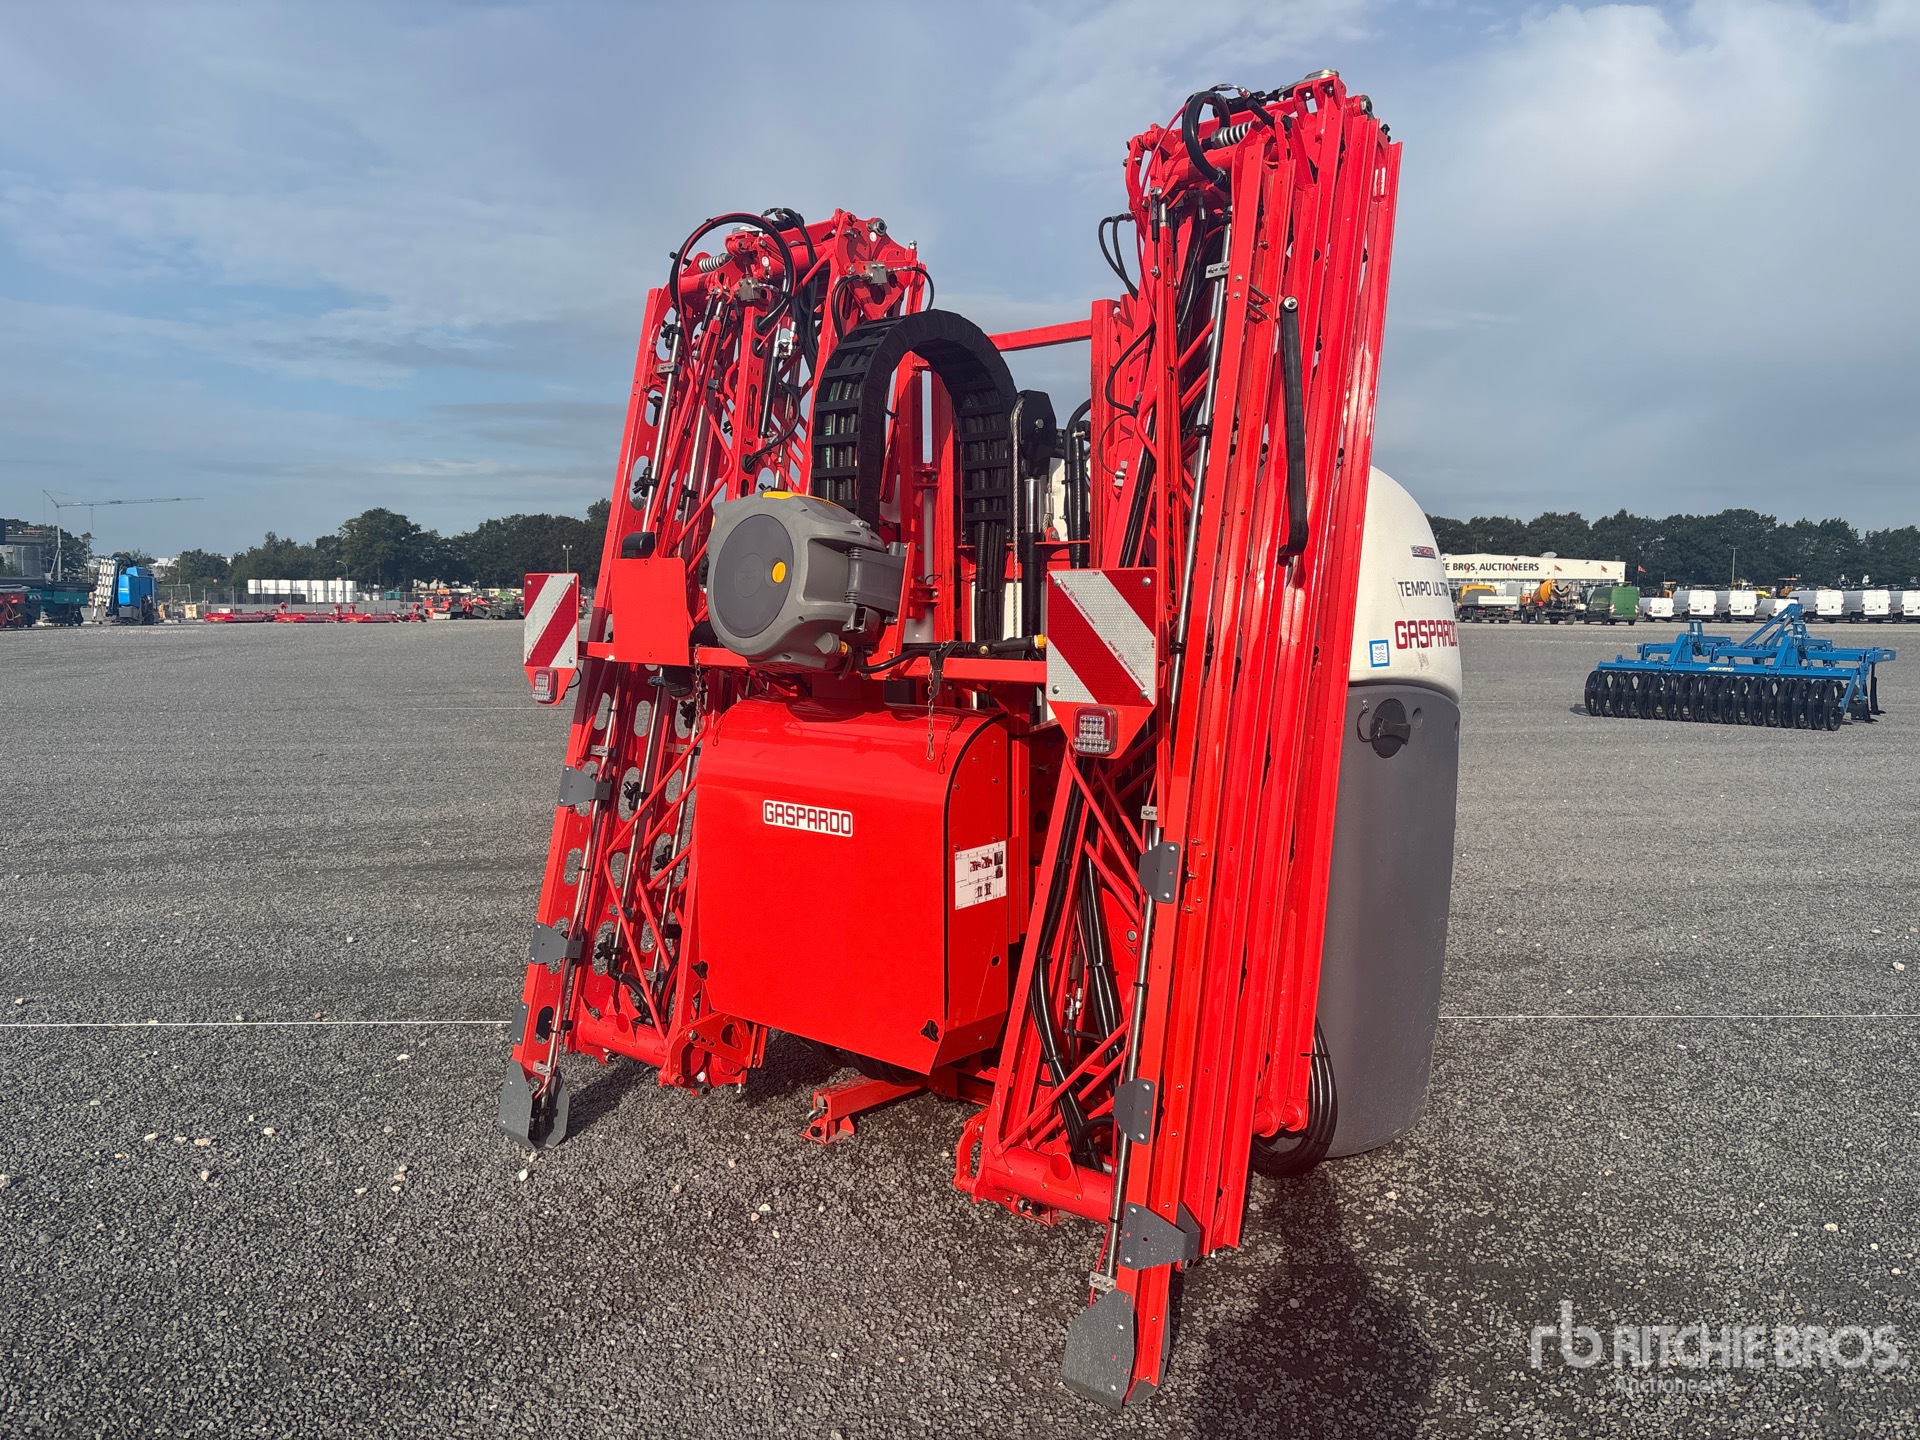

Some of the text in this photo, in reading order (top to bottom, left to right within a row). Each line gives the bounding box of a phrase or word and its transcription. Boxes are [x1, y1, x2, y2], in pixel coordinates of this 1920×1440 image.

[1453, 563, 1478, 571] BROS.
[1479, 563, 1540, 571] AUCTIONEERS
[1398, 581, 1431, 597] TEMPO
[765, 802, 852, 835] GASPARDO
